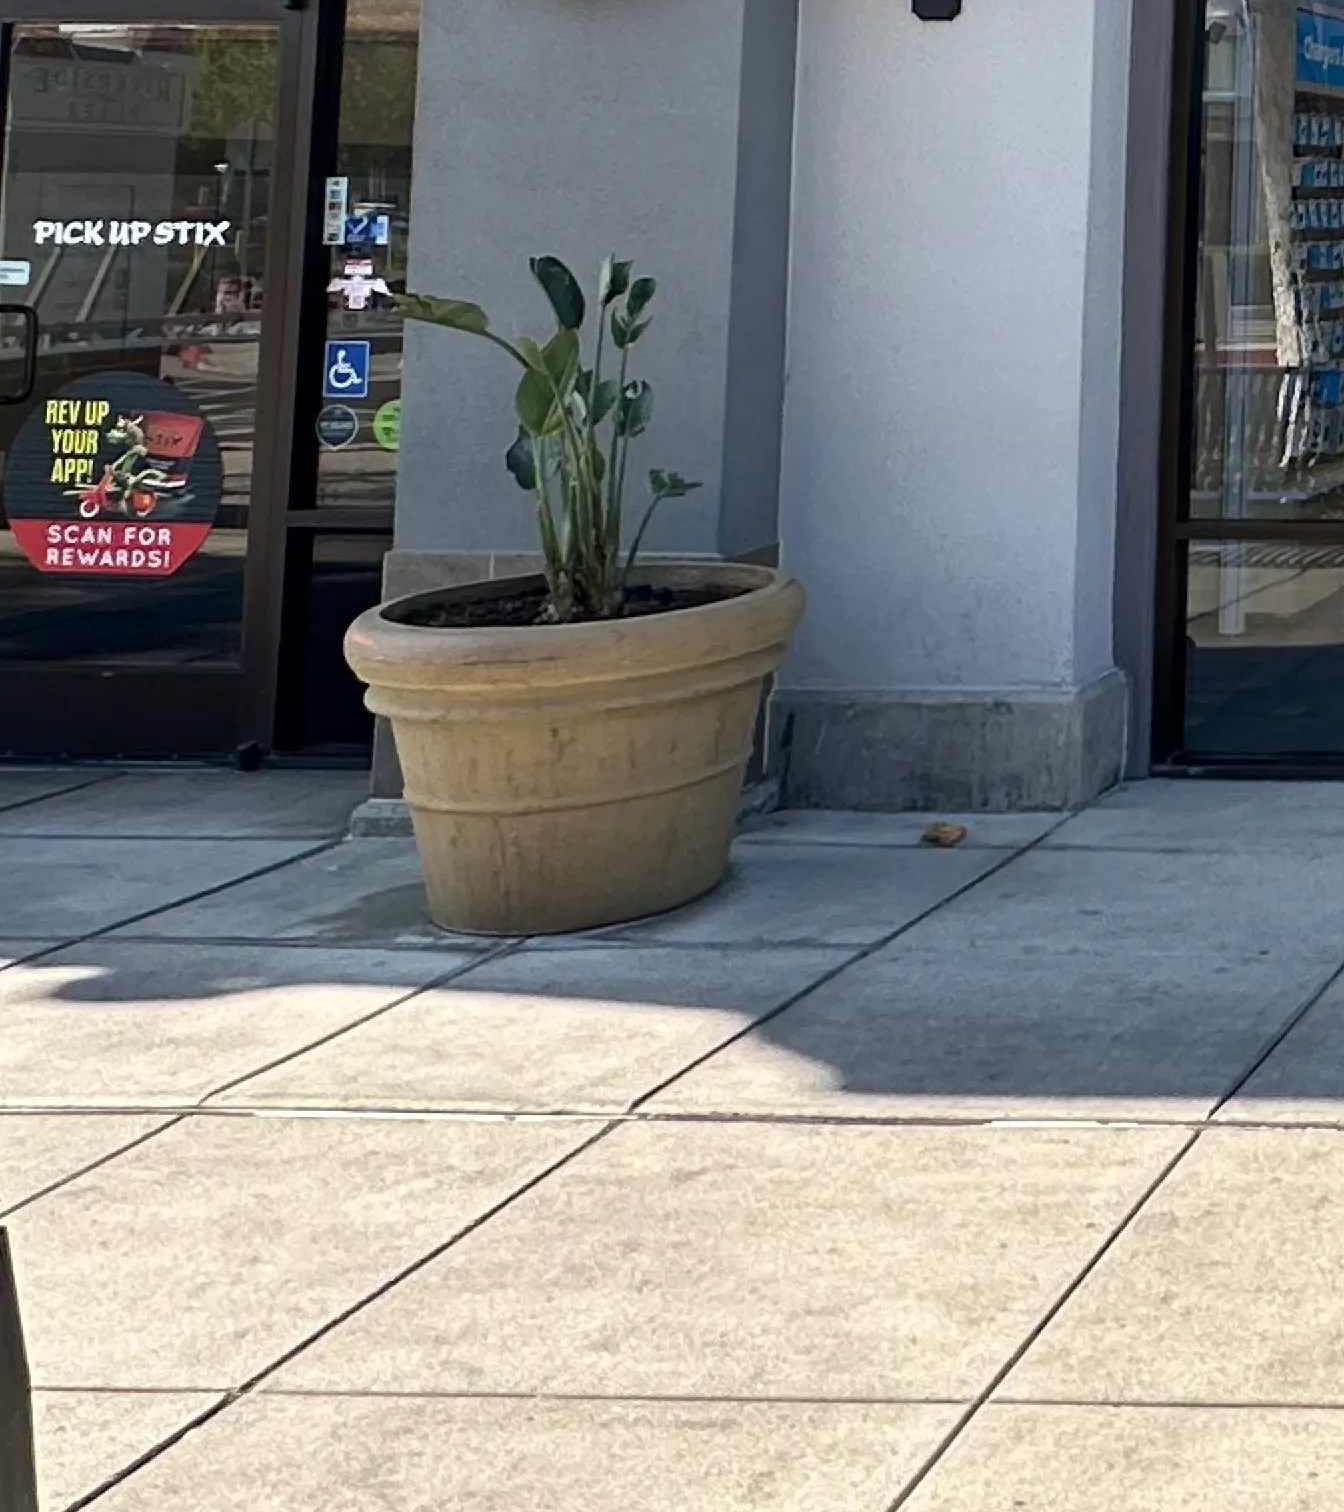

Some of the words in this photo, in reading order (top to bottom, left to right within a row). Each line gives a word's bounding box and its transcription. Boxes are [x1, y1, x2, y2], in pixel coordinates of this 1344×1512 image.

[33, 220, 104, 246] PICK
[109, 220, 151, 246] UP
[153, 220, 231, 246] STIX
[45, 400, 83, 425] REV
[85, 400, 109, 425] UP
[51, 429, 99, 455] YOUR
[51, 458, 94, 484] APP!
[47, 524, 114, 545] SCAN
[124, 526, 172, 546] FOR
[45, 548, 171, 568] REWARDS!
